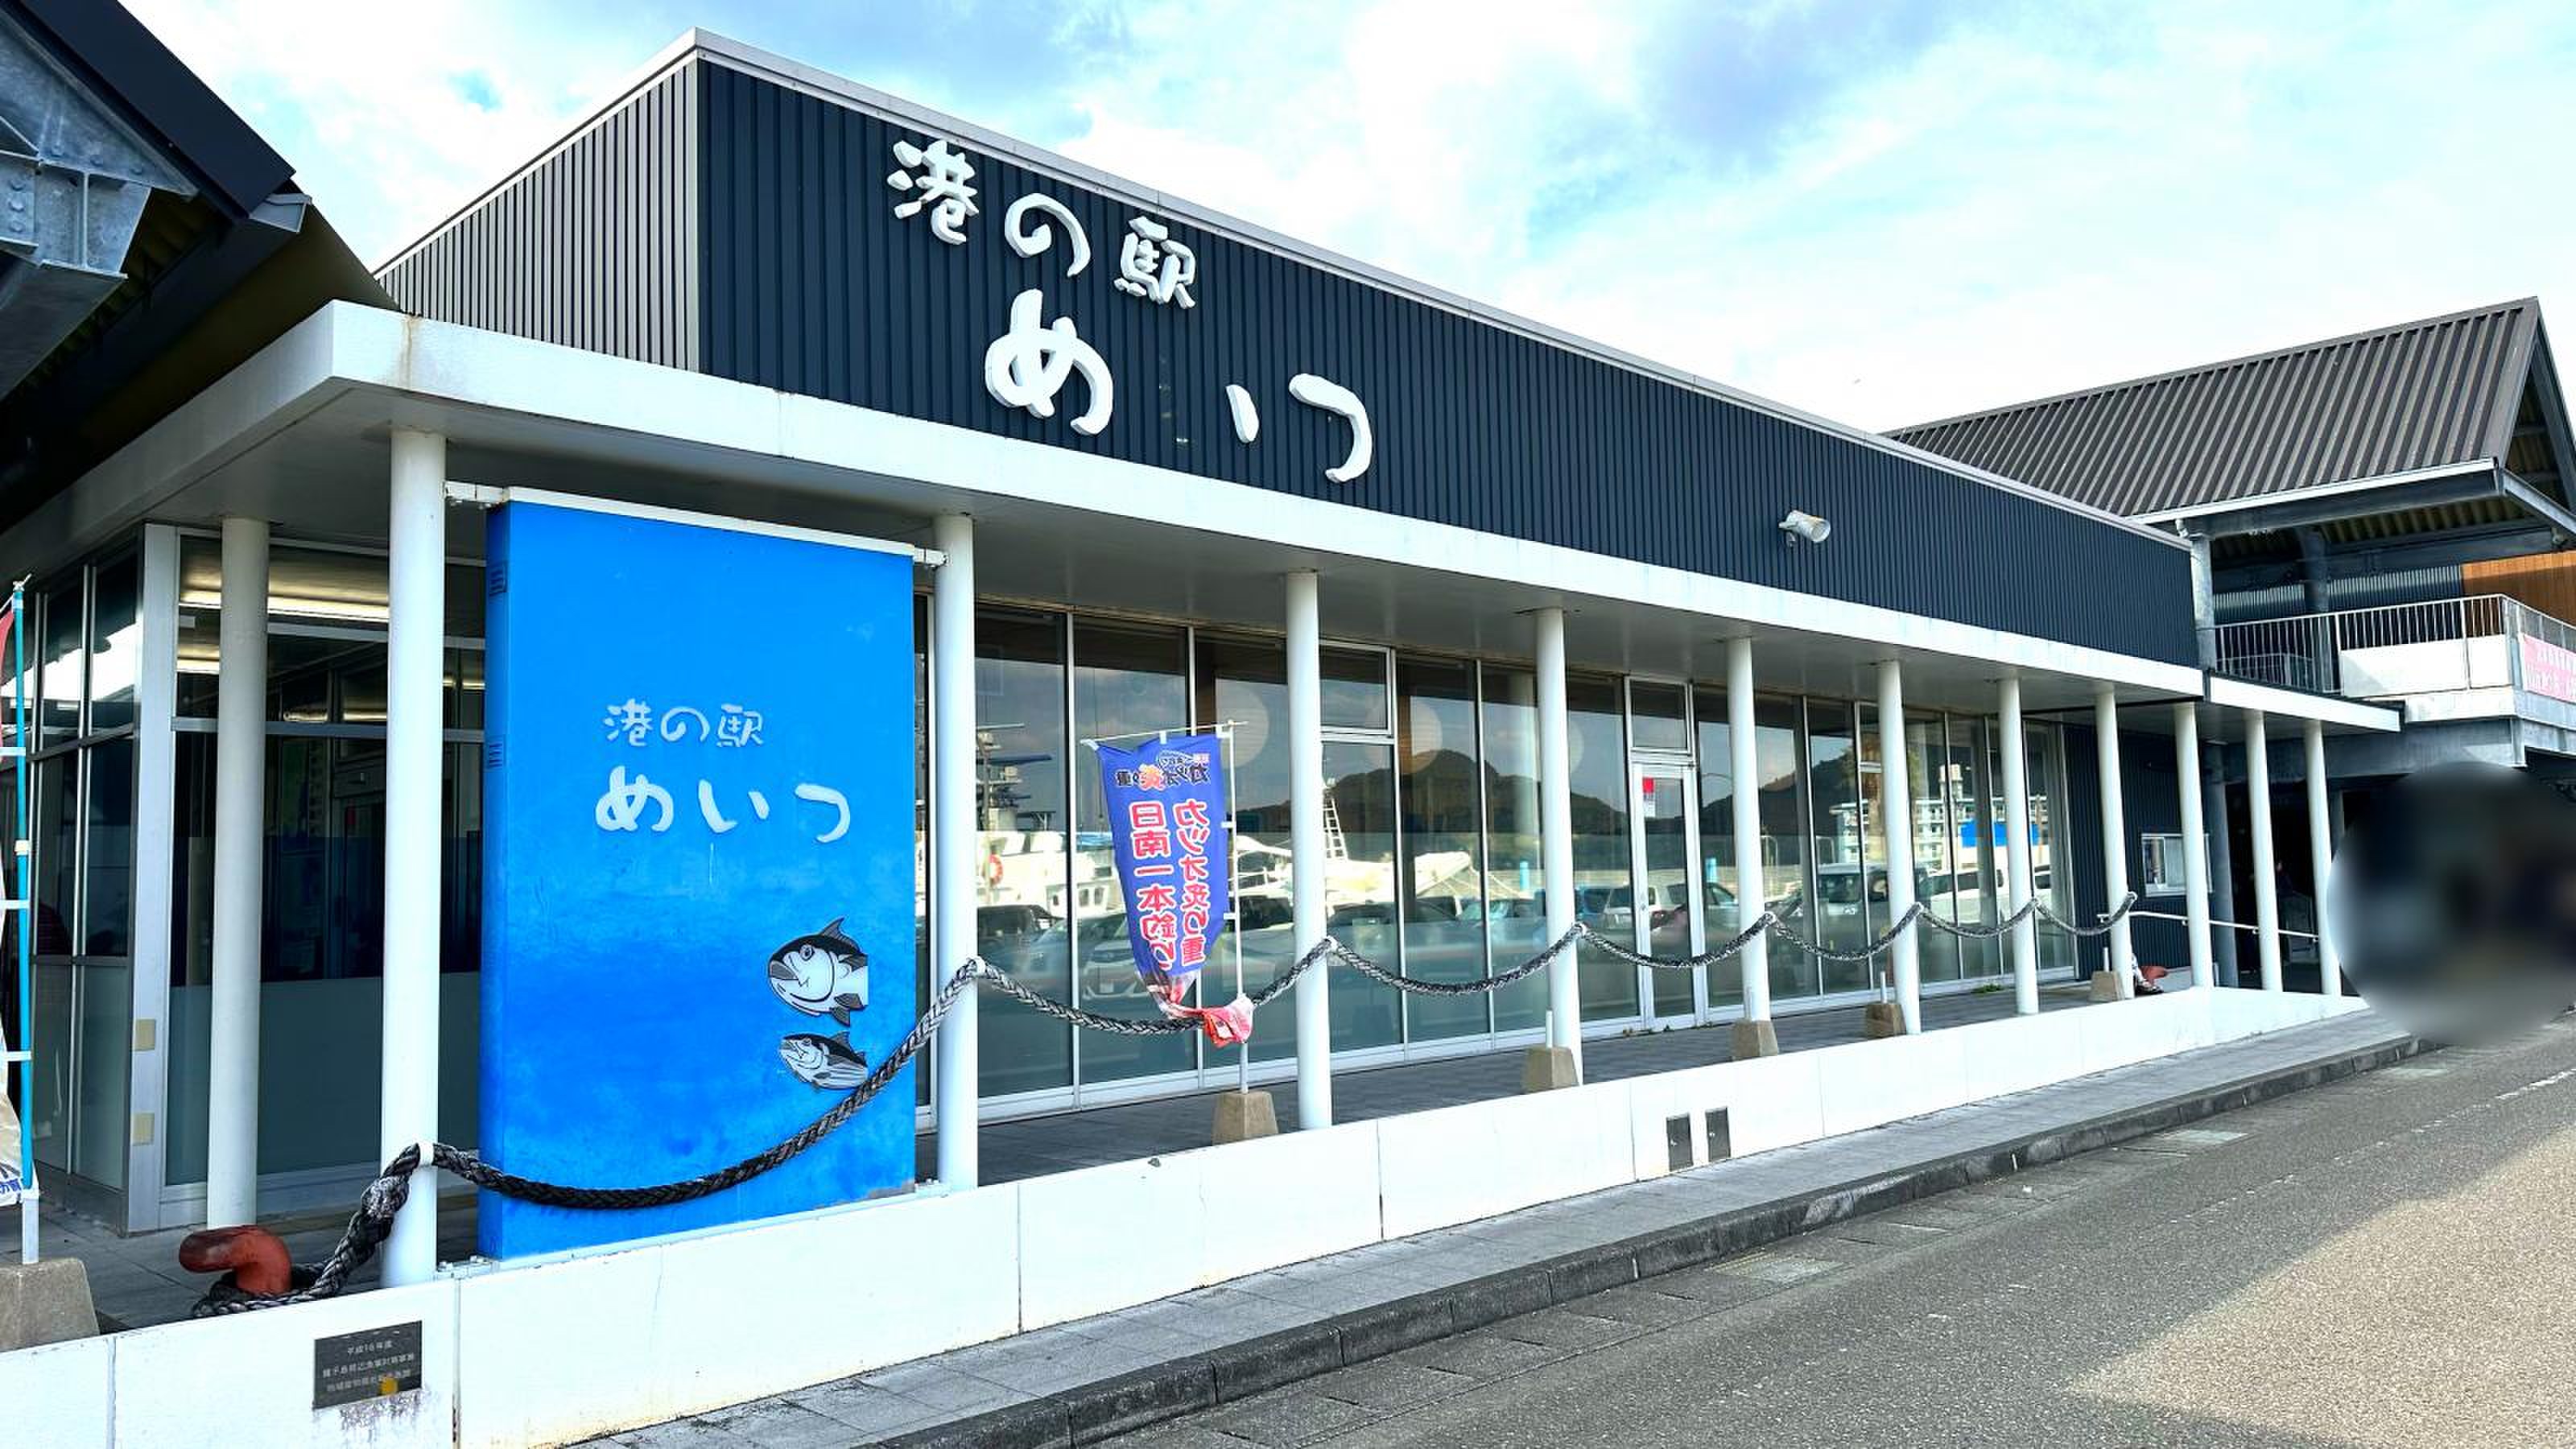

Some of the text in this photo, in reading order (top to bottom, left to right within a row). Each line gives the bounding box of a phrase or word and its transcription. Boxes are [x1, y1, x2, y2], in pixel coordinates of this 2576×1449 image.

[887, 139, 1197, 309] 港の駅
[602, 698, 764, 747] 港の駅
[595, 766, 851, 843] めいつ
